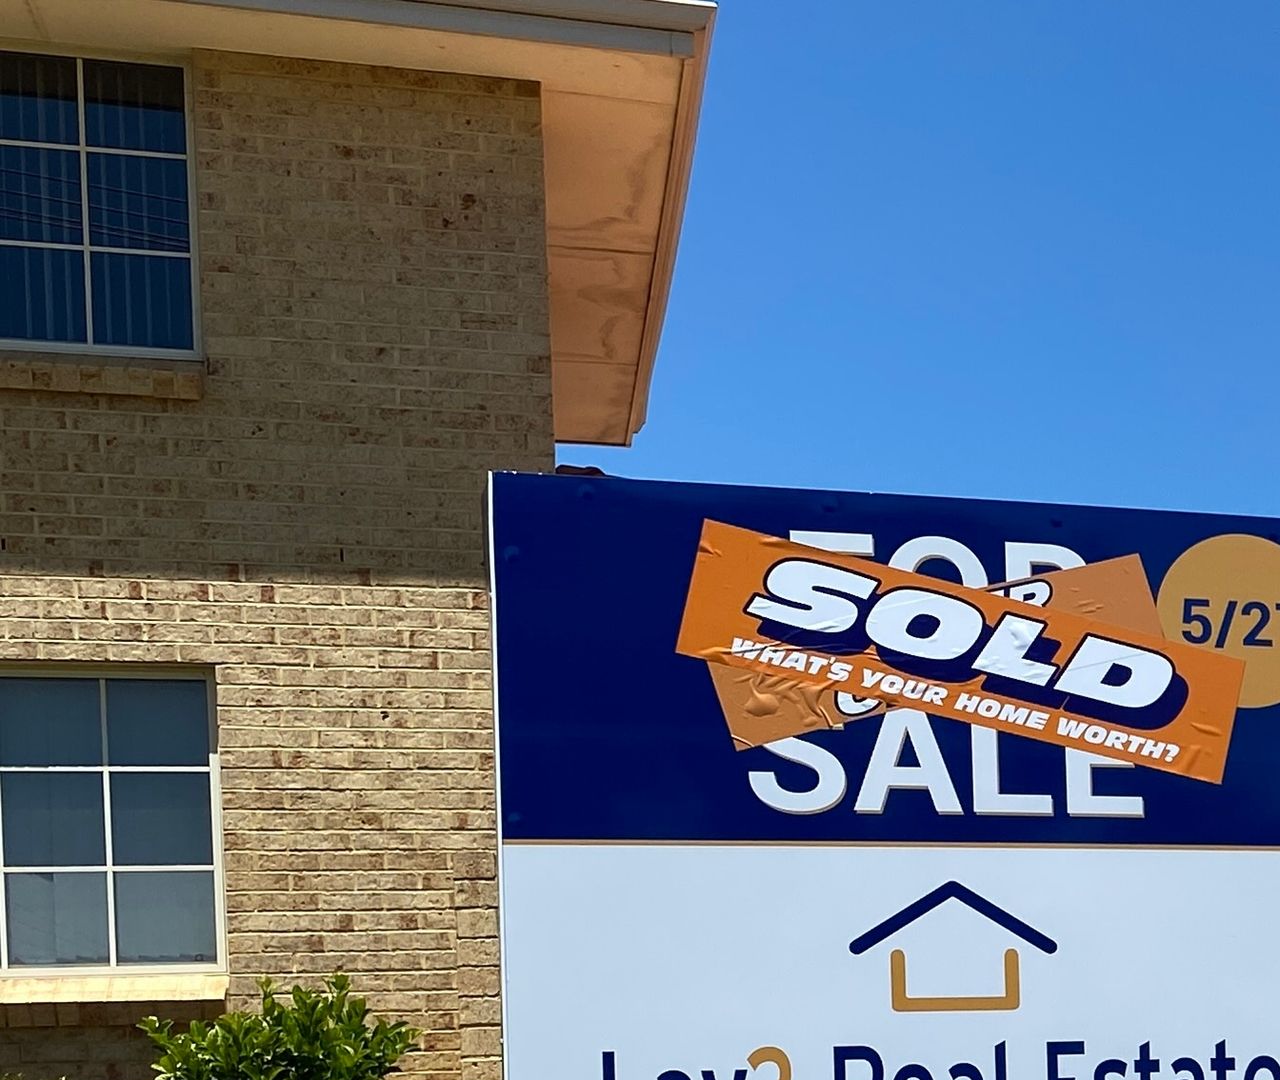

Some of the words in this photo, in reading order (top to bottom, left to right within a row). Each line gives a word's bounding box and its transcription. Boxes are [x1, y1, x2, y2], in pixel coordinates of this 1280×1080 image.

[744, 558, 1176, 710] SOLD
[731, 637, 853, 683] WHAT'S
[861, 667, 949, 706] YOUR
[953, 691, 1050, 731] HOME
[1056, 716, 1181, 763] WORTH?
[748, 708, 1145, 818] SALE
